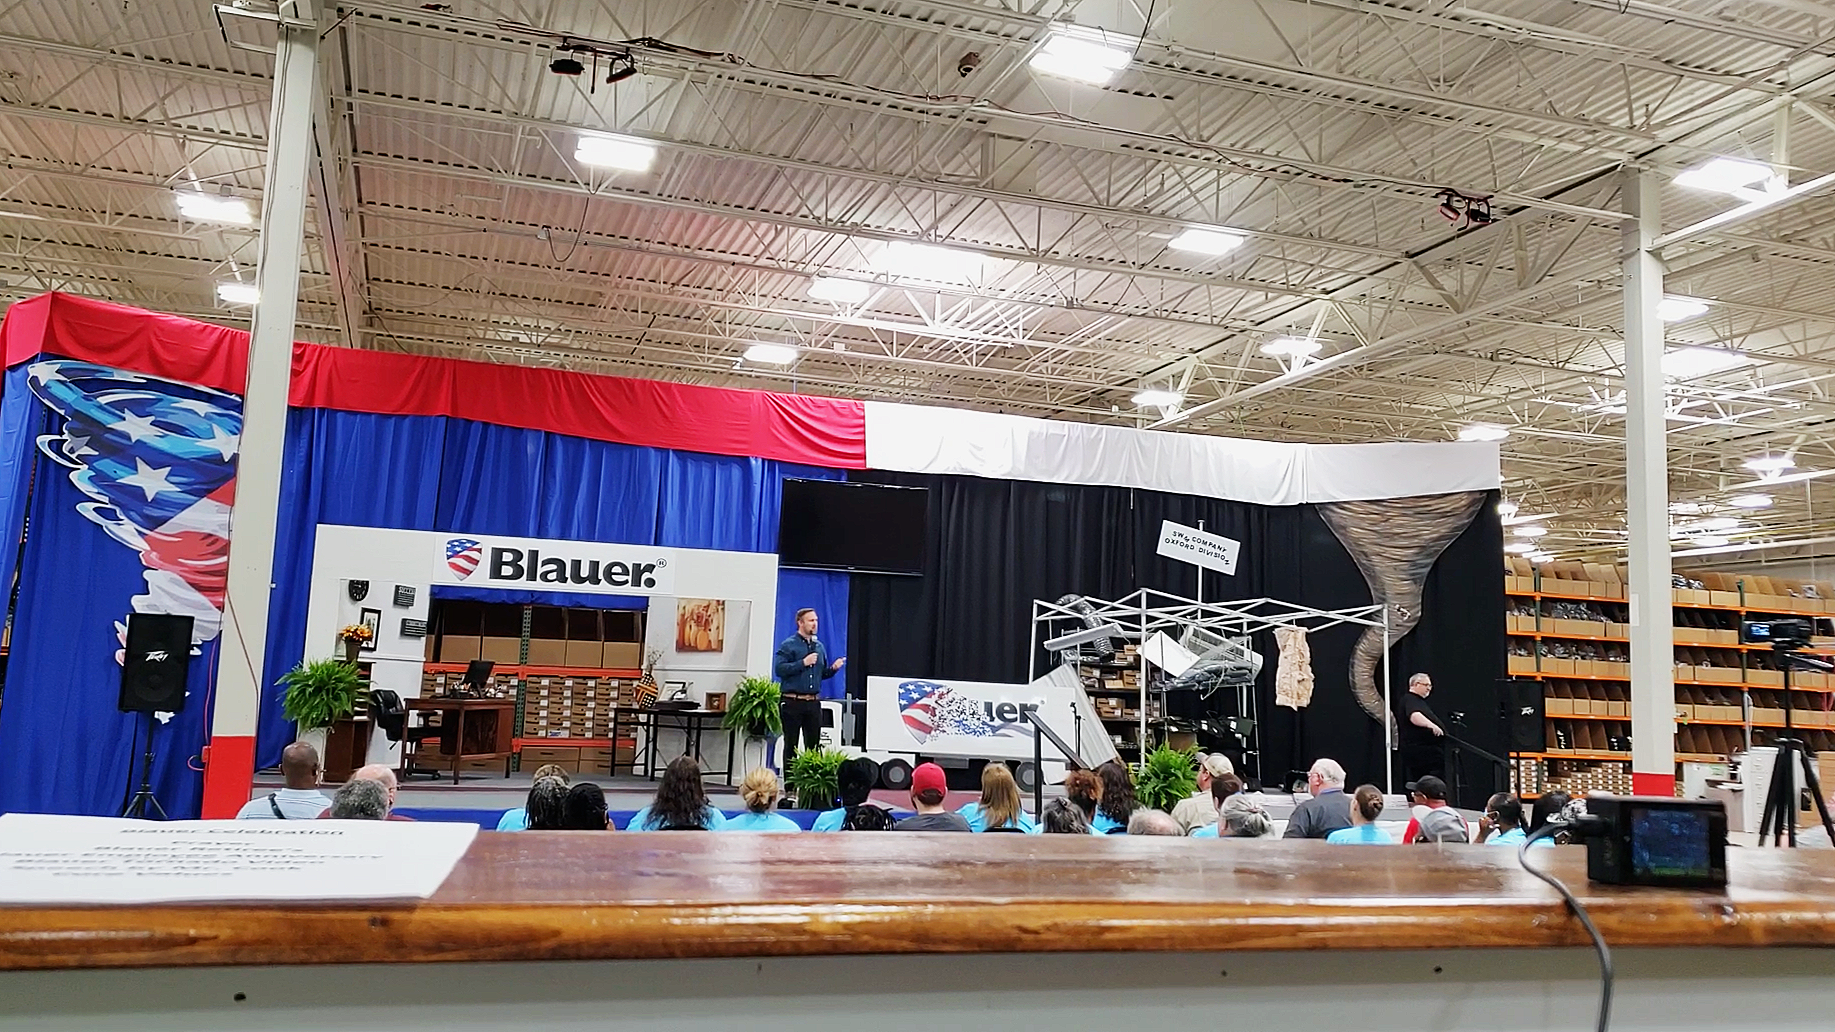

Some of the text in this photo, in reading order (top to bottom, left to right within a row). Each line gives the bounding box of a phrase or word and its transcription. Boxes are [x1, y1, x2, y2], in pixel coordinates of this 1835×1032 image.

[1164, 537, 1230, 565] OXFORD DIVISION
[1192, 536, 1228, 553] COMPANY
